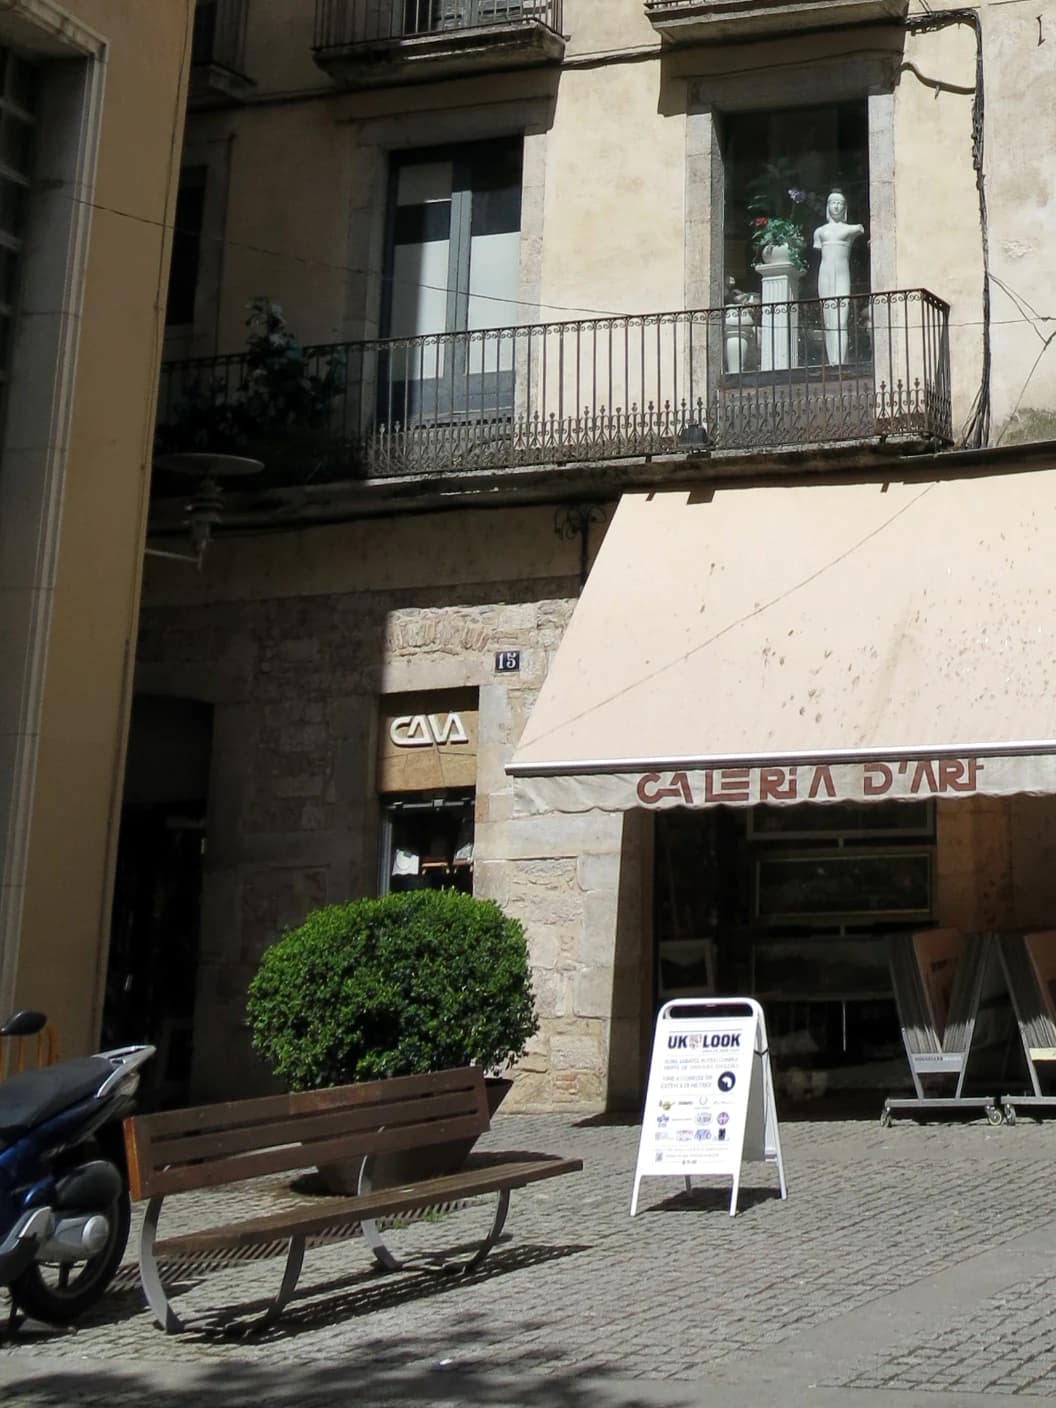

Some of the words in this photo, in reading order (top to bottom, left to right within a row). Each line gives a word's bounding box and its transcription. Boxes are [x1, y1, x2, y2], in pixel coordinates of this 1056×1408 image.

[498, 652, 516, 669] 15
[667, 1035, 688, 1049] UK
[702, 1033, 741, 1048] LOOK
